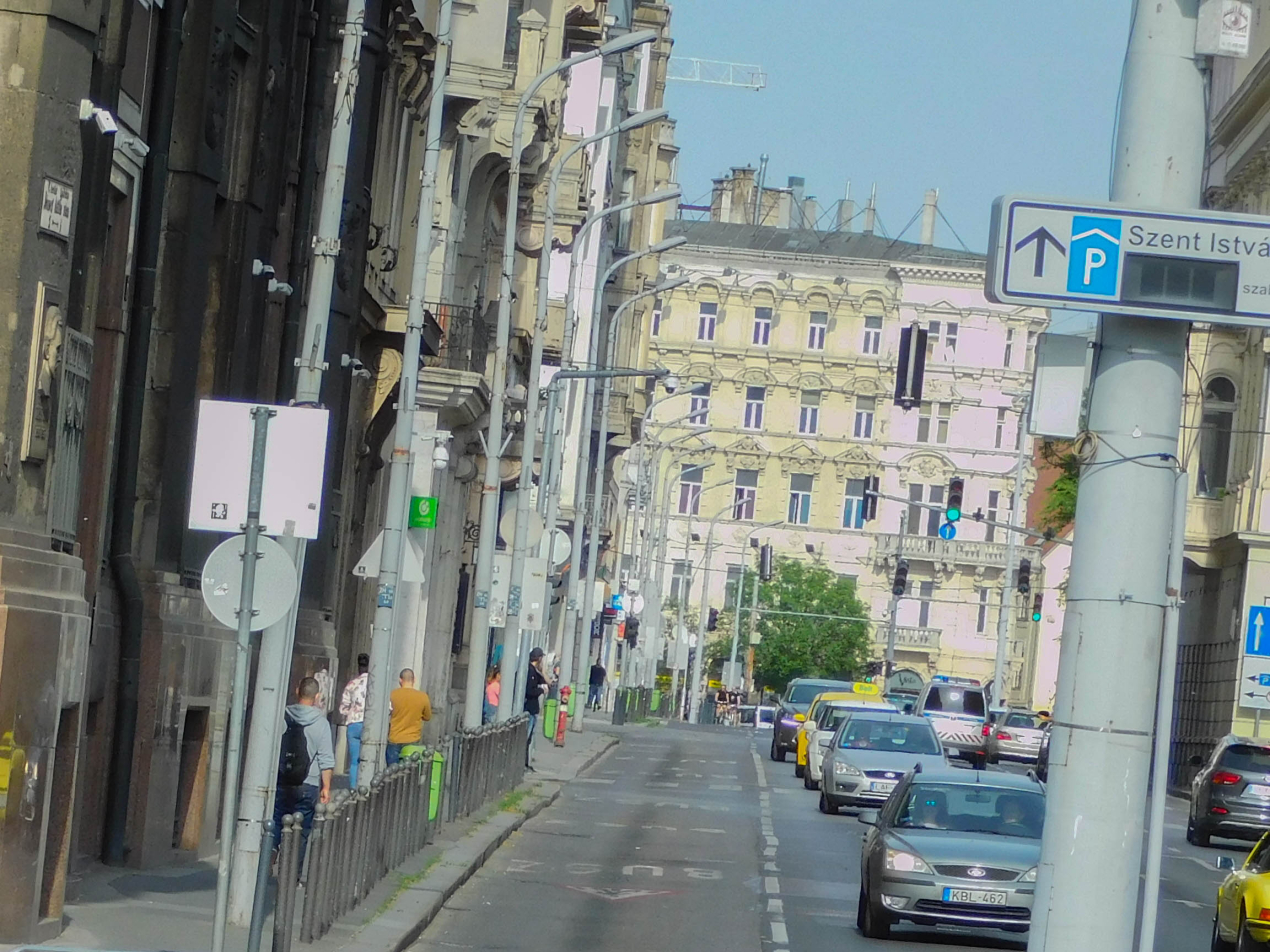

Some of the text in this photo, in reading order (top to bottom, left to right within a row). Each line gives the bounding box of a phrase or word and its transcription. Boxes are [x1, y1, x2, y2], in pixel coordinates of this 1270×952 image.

[1128, 225, 1201, 251] Szent
[1084, 247, 1107, 285] P
[952, 890, 1004, 904] KBL-462
